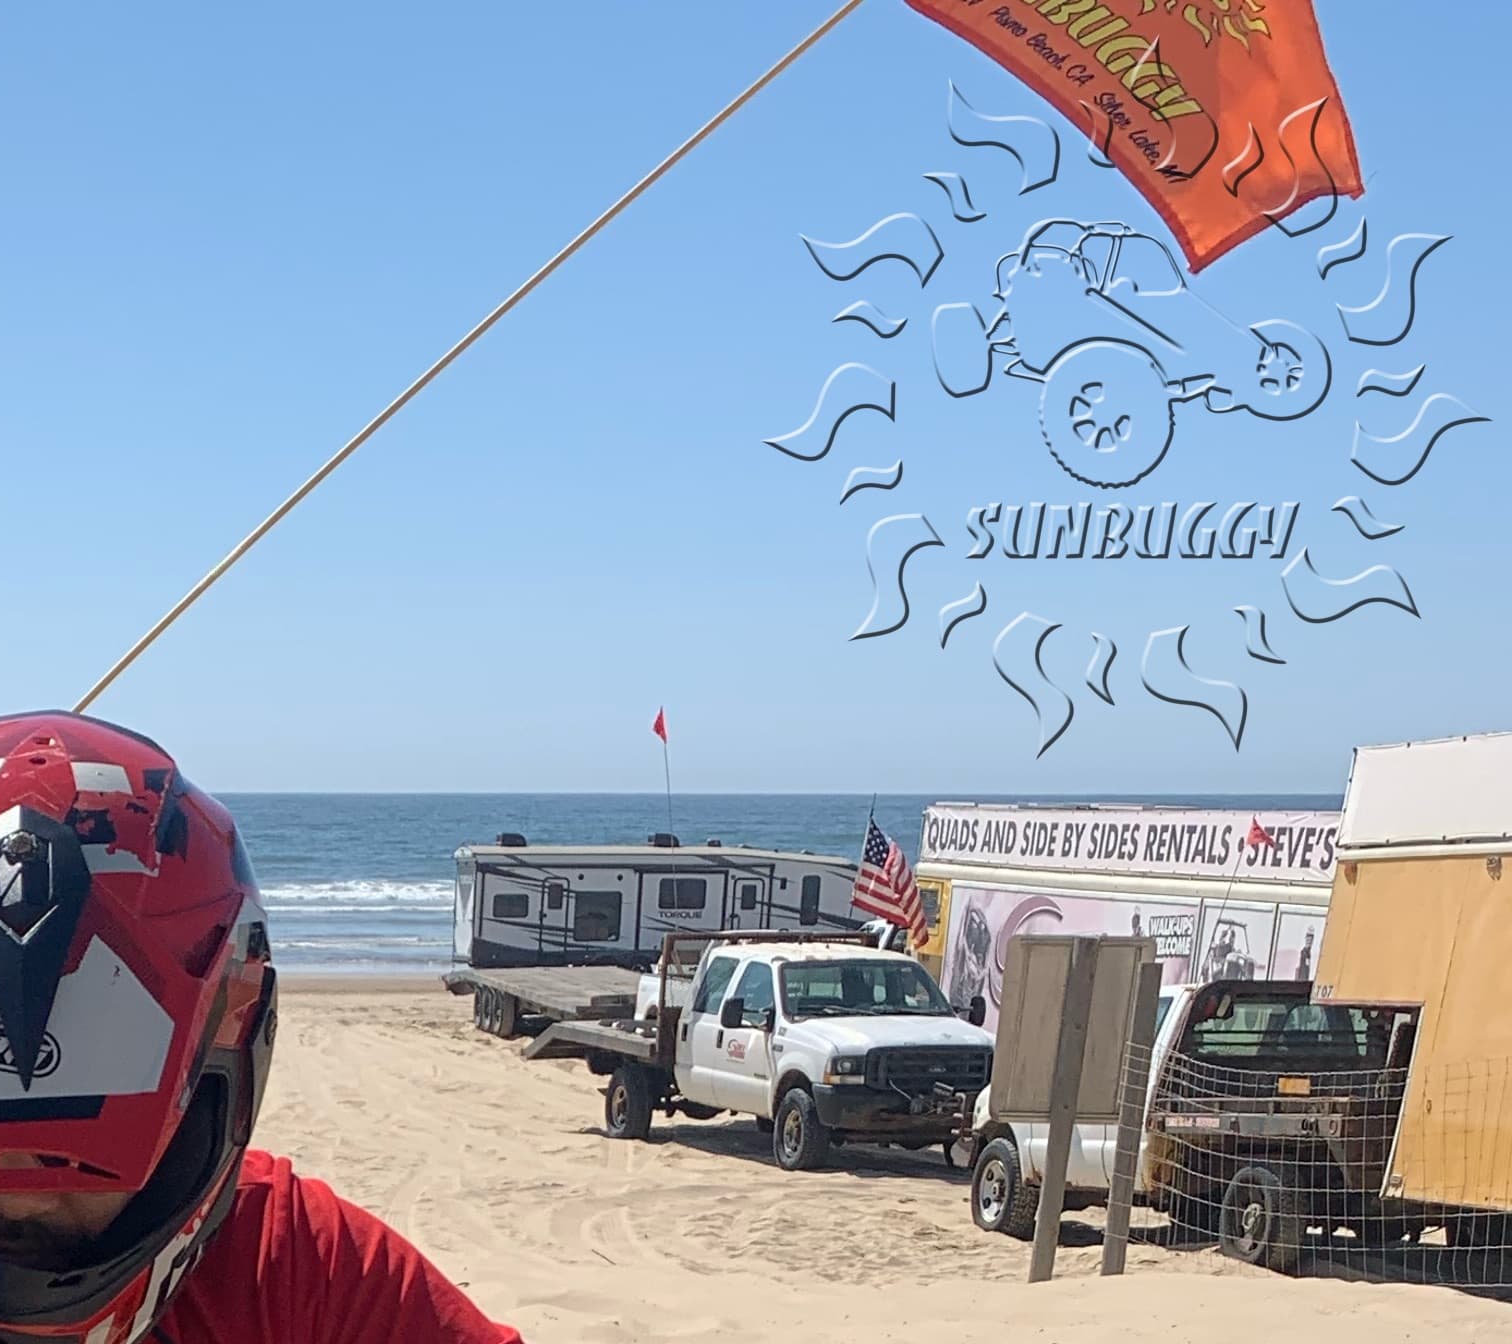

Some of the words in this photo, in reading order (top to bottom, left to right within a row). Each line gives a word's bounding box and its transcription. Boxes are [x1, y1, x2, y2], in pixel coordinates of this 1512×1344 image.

[1020, 0, 1204, 122] BUGGY
[1066, 64, 1095, 87] CA
[927, 818, 980, 853] QUADS
[980, 819, 1018, 855] AND
[1020, 821, 1059, 857] SIDE
[1060, 822, 1089, 859] BY
[1087, 822, 1141, 861] SIDES
[1143, 824, 1233, 866] RENTALS
[657, 910, 703, 919] TORQUE
[1154, 936, 1192, 956] ELCOME
